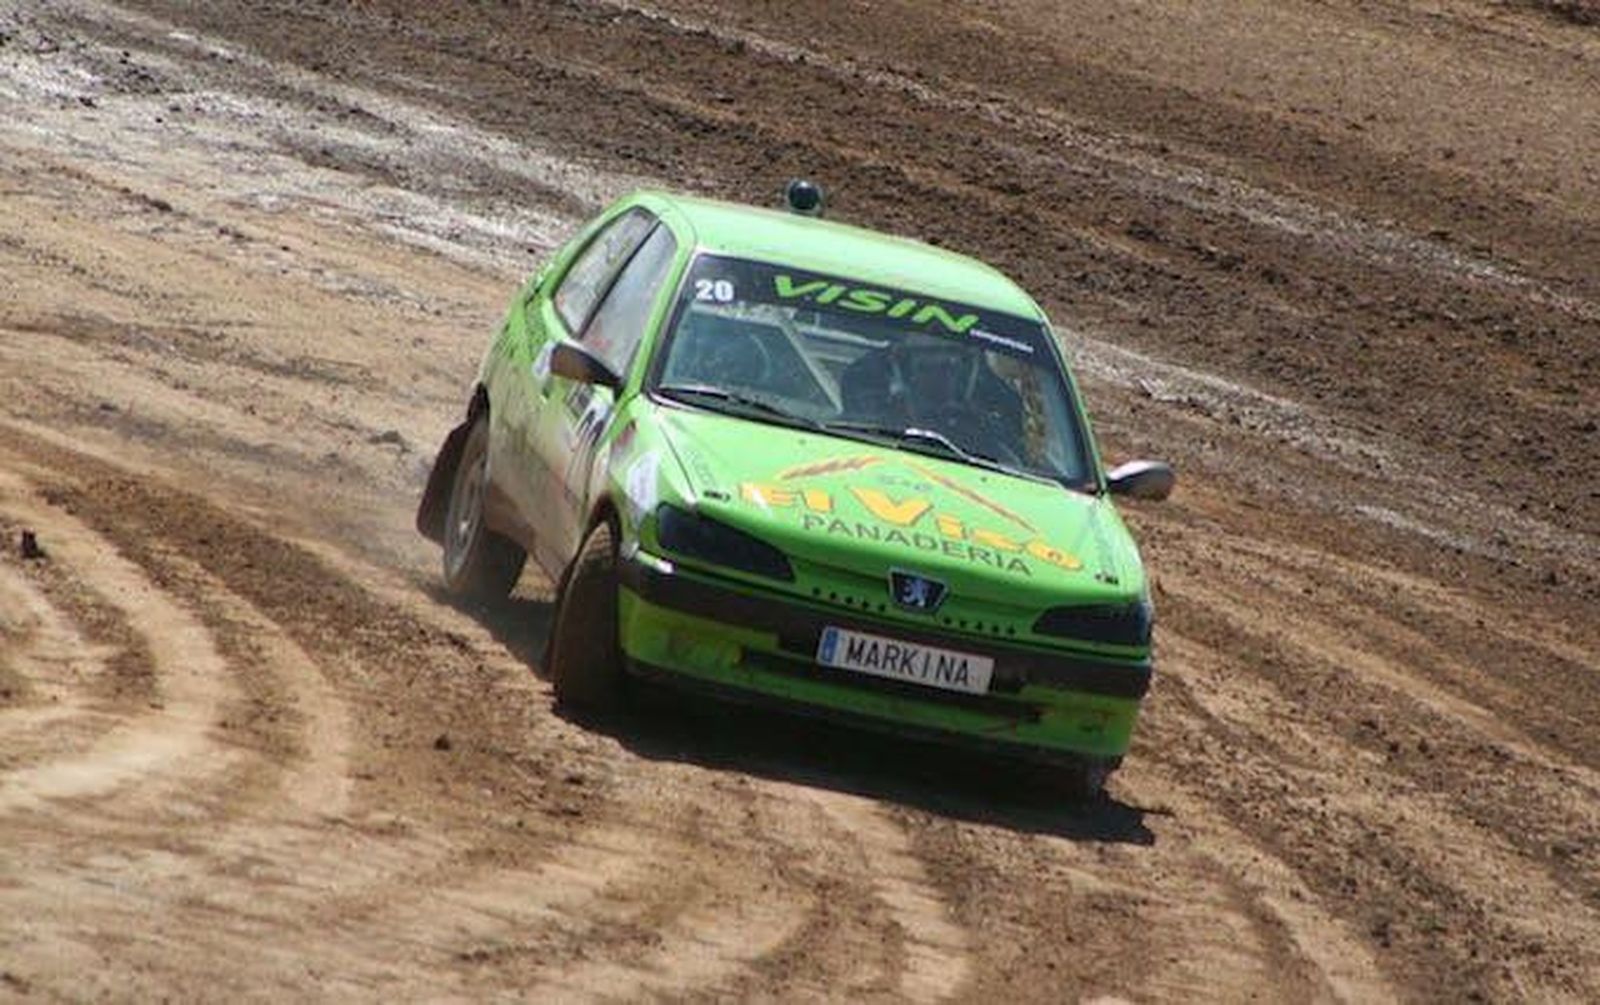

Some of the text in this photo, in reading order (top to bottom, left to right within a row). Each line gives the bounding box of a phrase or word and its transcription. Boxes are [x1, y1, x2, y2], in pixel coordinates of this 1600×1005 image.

[694, 278, 735, 303] 20
[774, 274, 980, 334] VISIN
[802, 512, 1034, 577] PANADERIA
[844, 635, 970, 687] MARKINA
